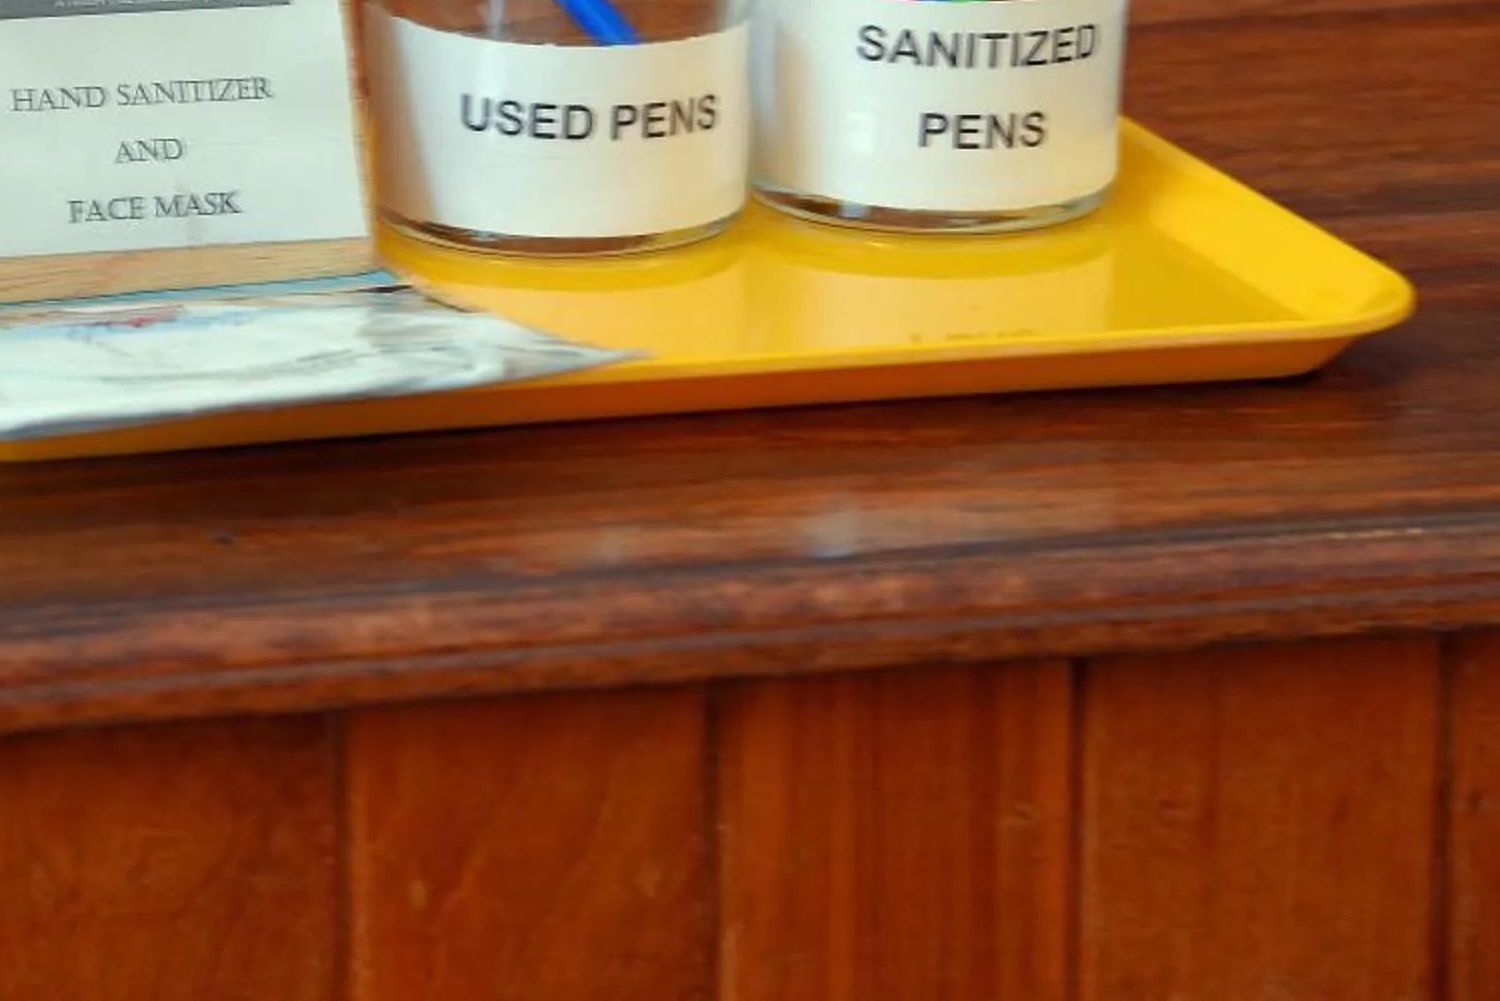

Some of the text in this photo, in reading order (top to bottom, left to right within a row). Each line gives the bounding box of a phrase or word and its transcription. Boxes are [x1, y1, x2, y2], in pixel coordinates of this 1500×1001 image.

[856, 22, 1097, 68] SANITIZED
[11, 76, 274, 112] HAND SANITIZER
[459, 92, 718, 141] USED PENS
[919, 111, 1046, 150] PENS
[114, 137, 184, 164] AND
[67, 190, 244, 223] FACE MASK
